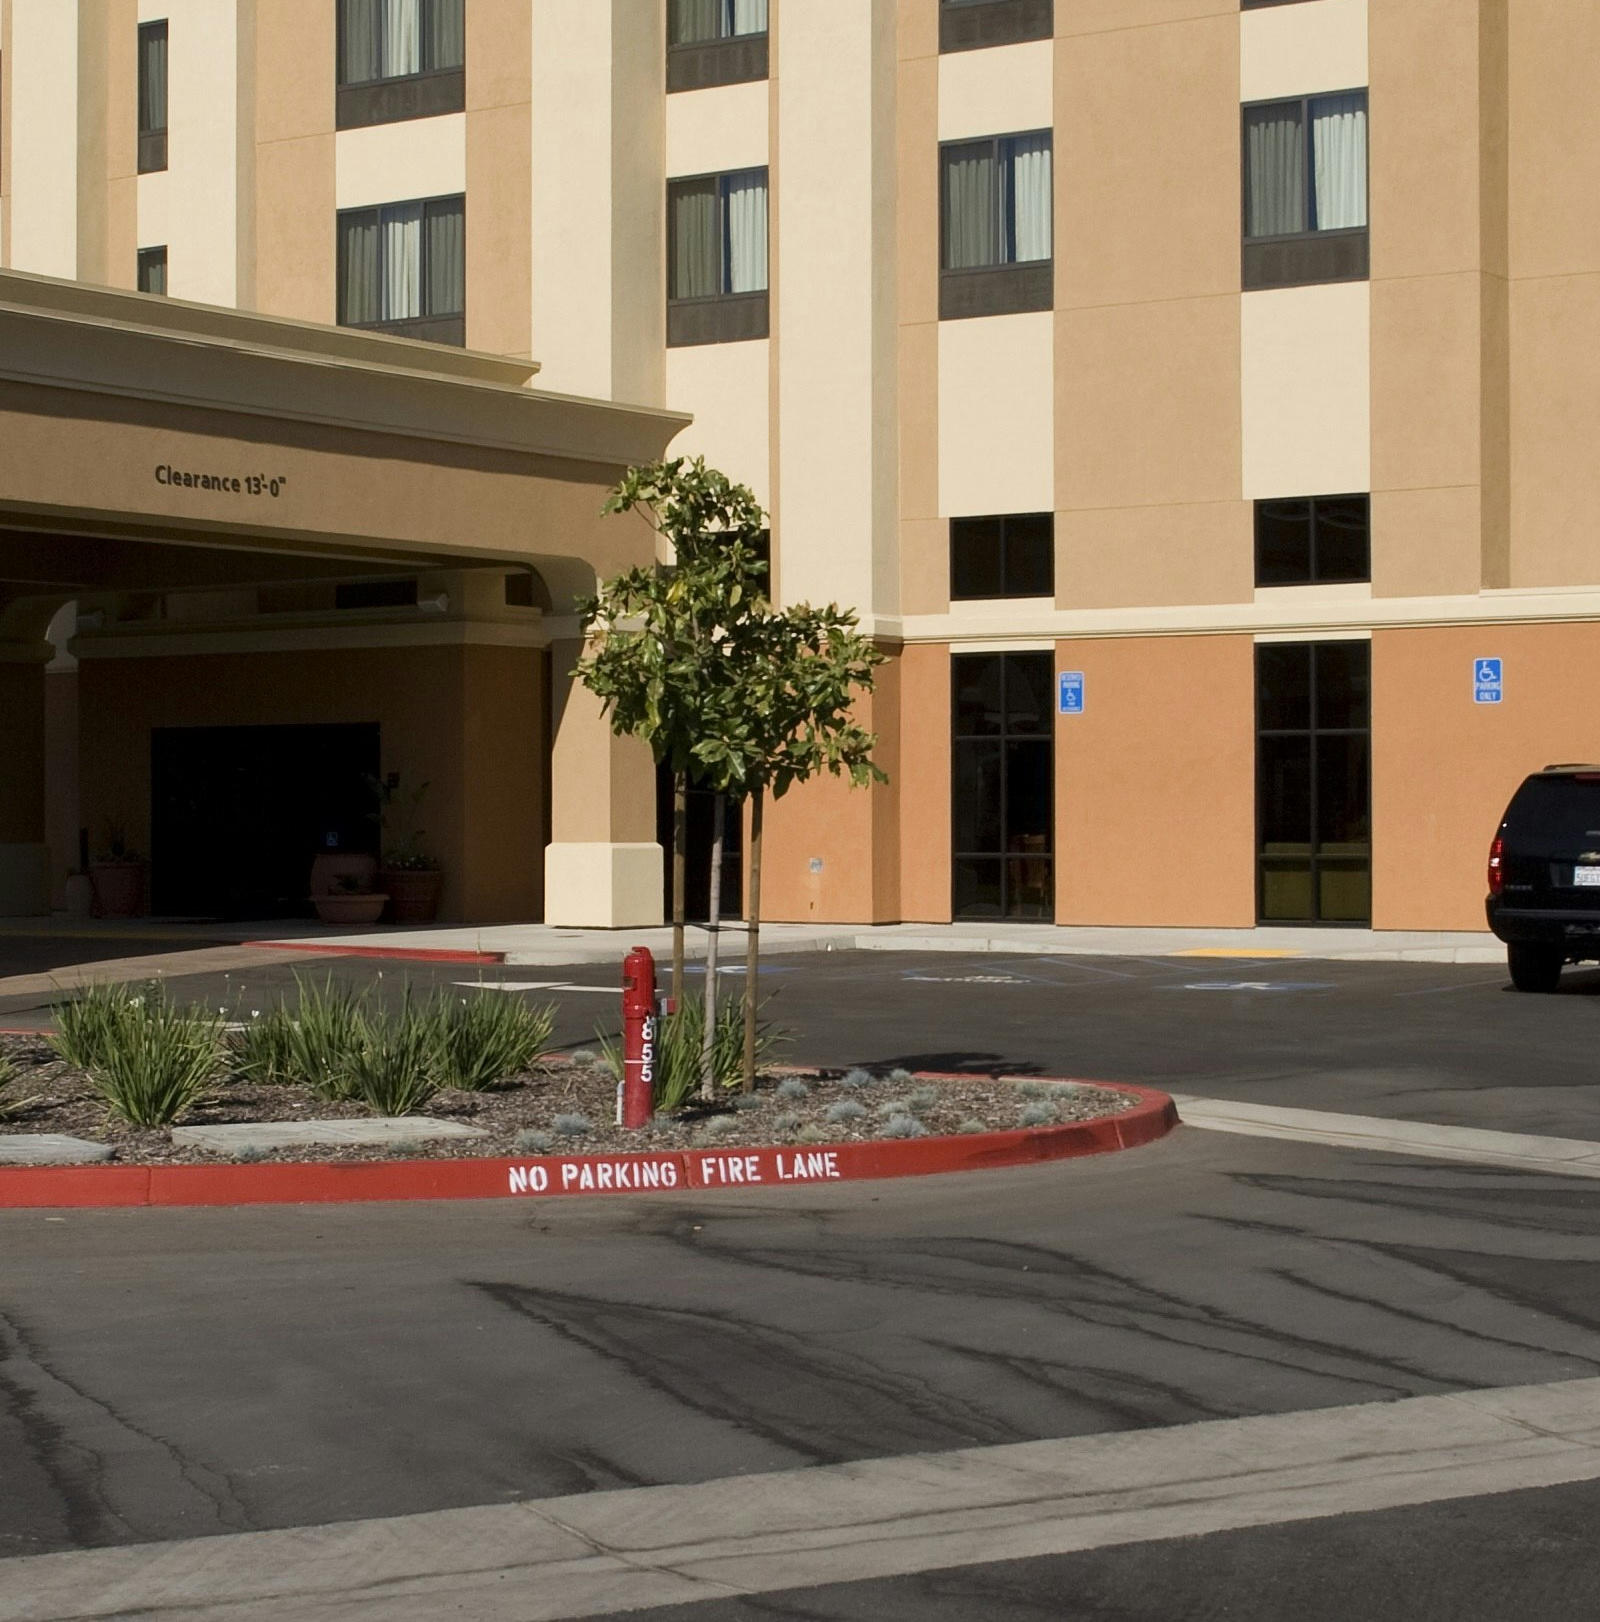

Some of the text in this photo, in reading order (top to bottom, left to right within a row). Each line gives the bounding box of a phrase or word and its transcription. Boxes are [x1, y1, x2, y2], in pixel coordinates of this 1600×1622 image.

[154, 464, 241, 494] Clearance
[640, 1021, 653, 1082] 855
[509, 1152, 840, 1194] NO PARKING FIRE LANE
